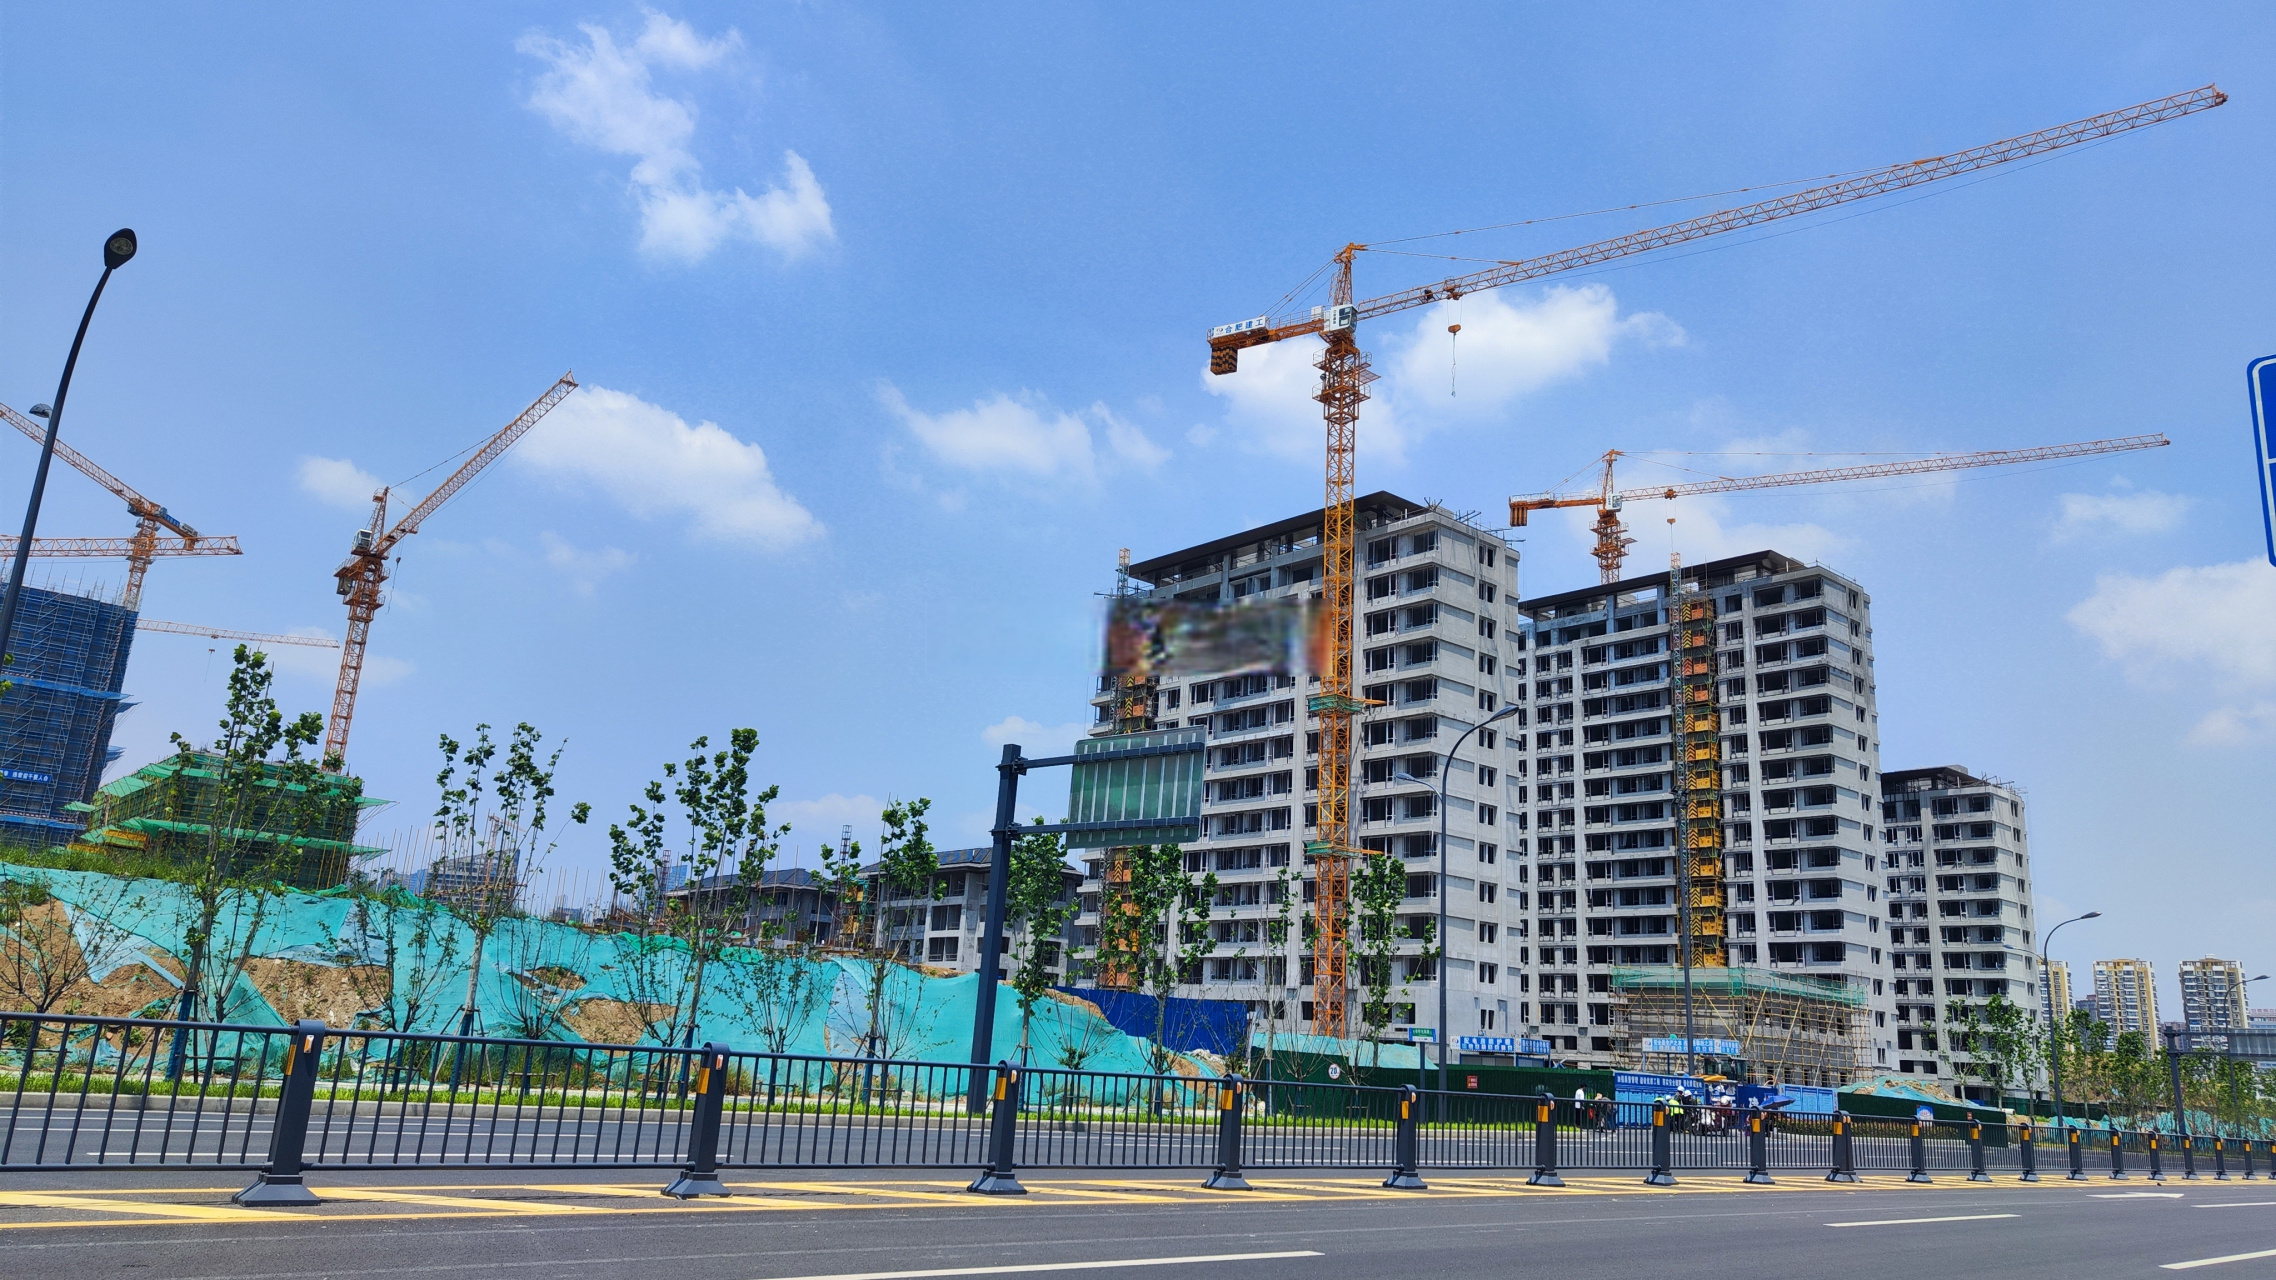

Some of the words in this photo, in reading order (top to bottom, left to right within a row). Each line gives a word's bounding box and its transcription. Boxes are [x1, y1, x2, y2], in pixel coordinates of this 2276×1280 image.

[1225, 318, 1263, 334] 合肥建工
[1330, 1067, 1338, 1075] 20
